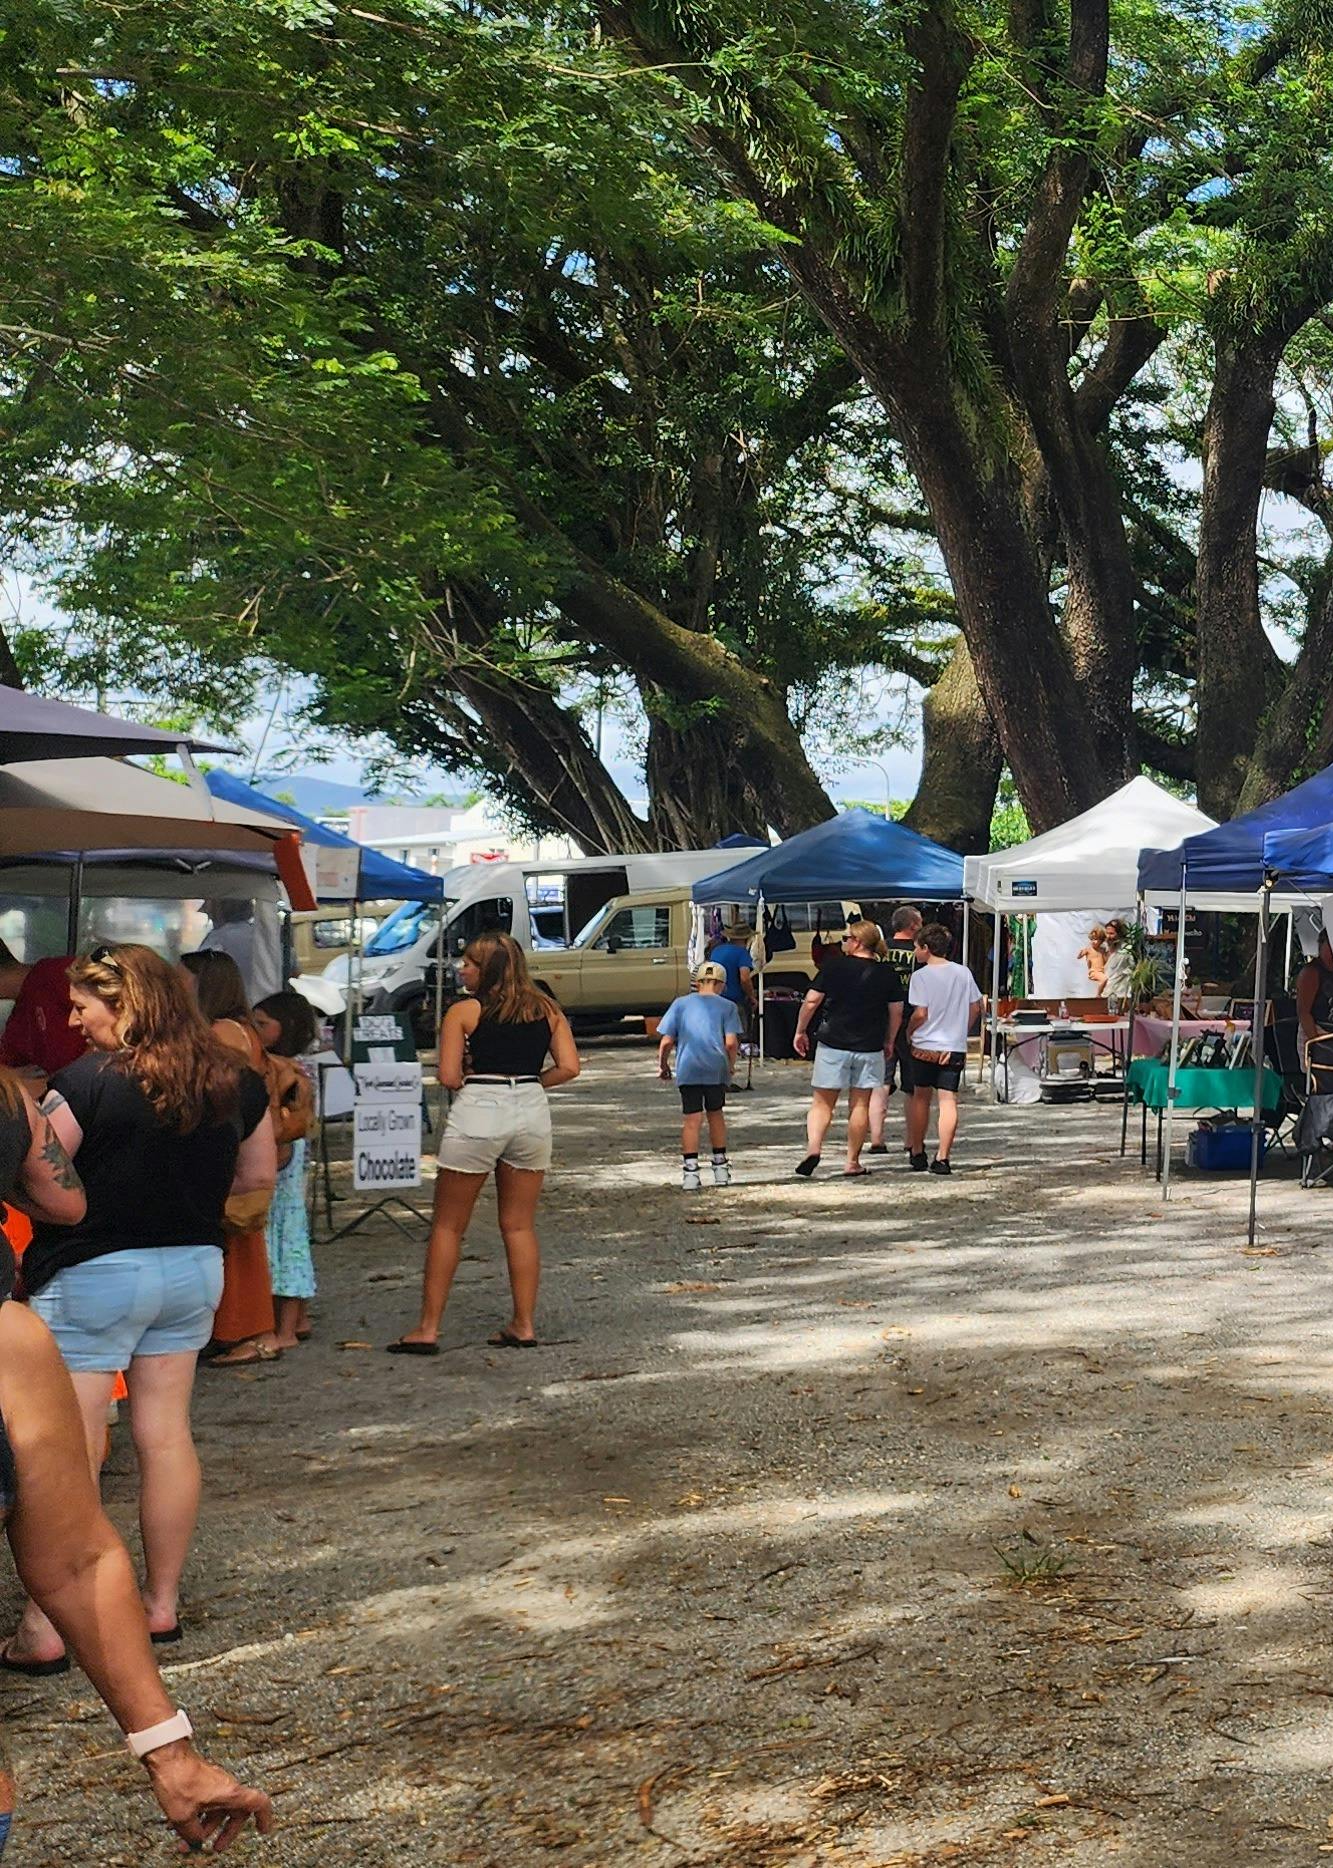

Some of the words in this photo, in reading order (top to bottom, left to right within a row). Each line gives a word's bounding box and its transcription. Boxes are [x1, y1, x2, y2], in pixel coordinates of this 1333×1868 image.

[358, 1110, 386, 1136] Locally
[388, 1110, 415, 1131] Grown
[358, 1151, 416, 1181] Chocolate
